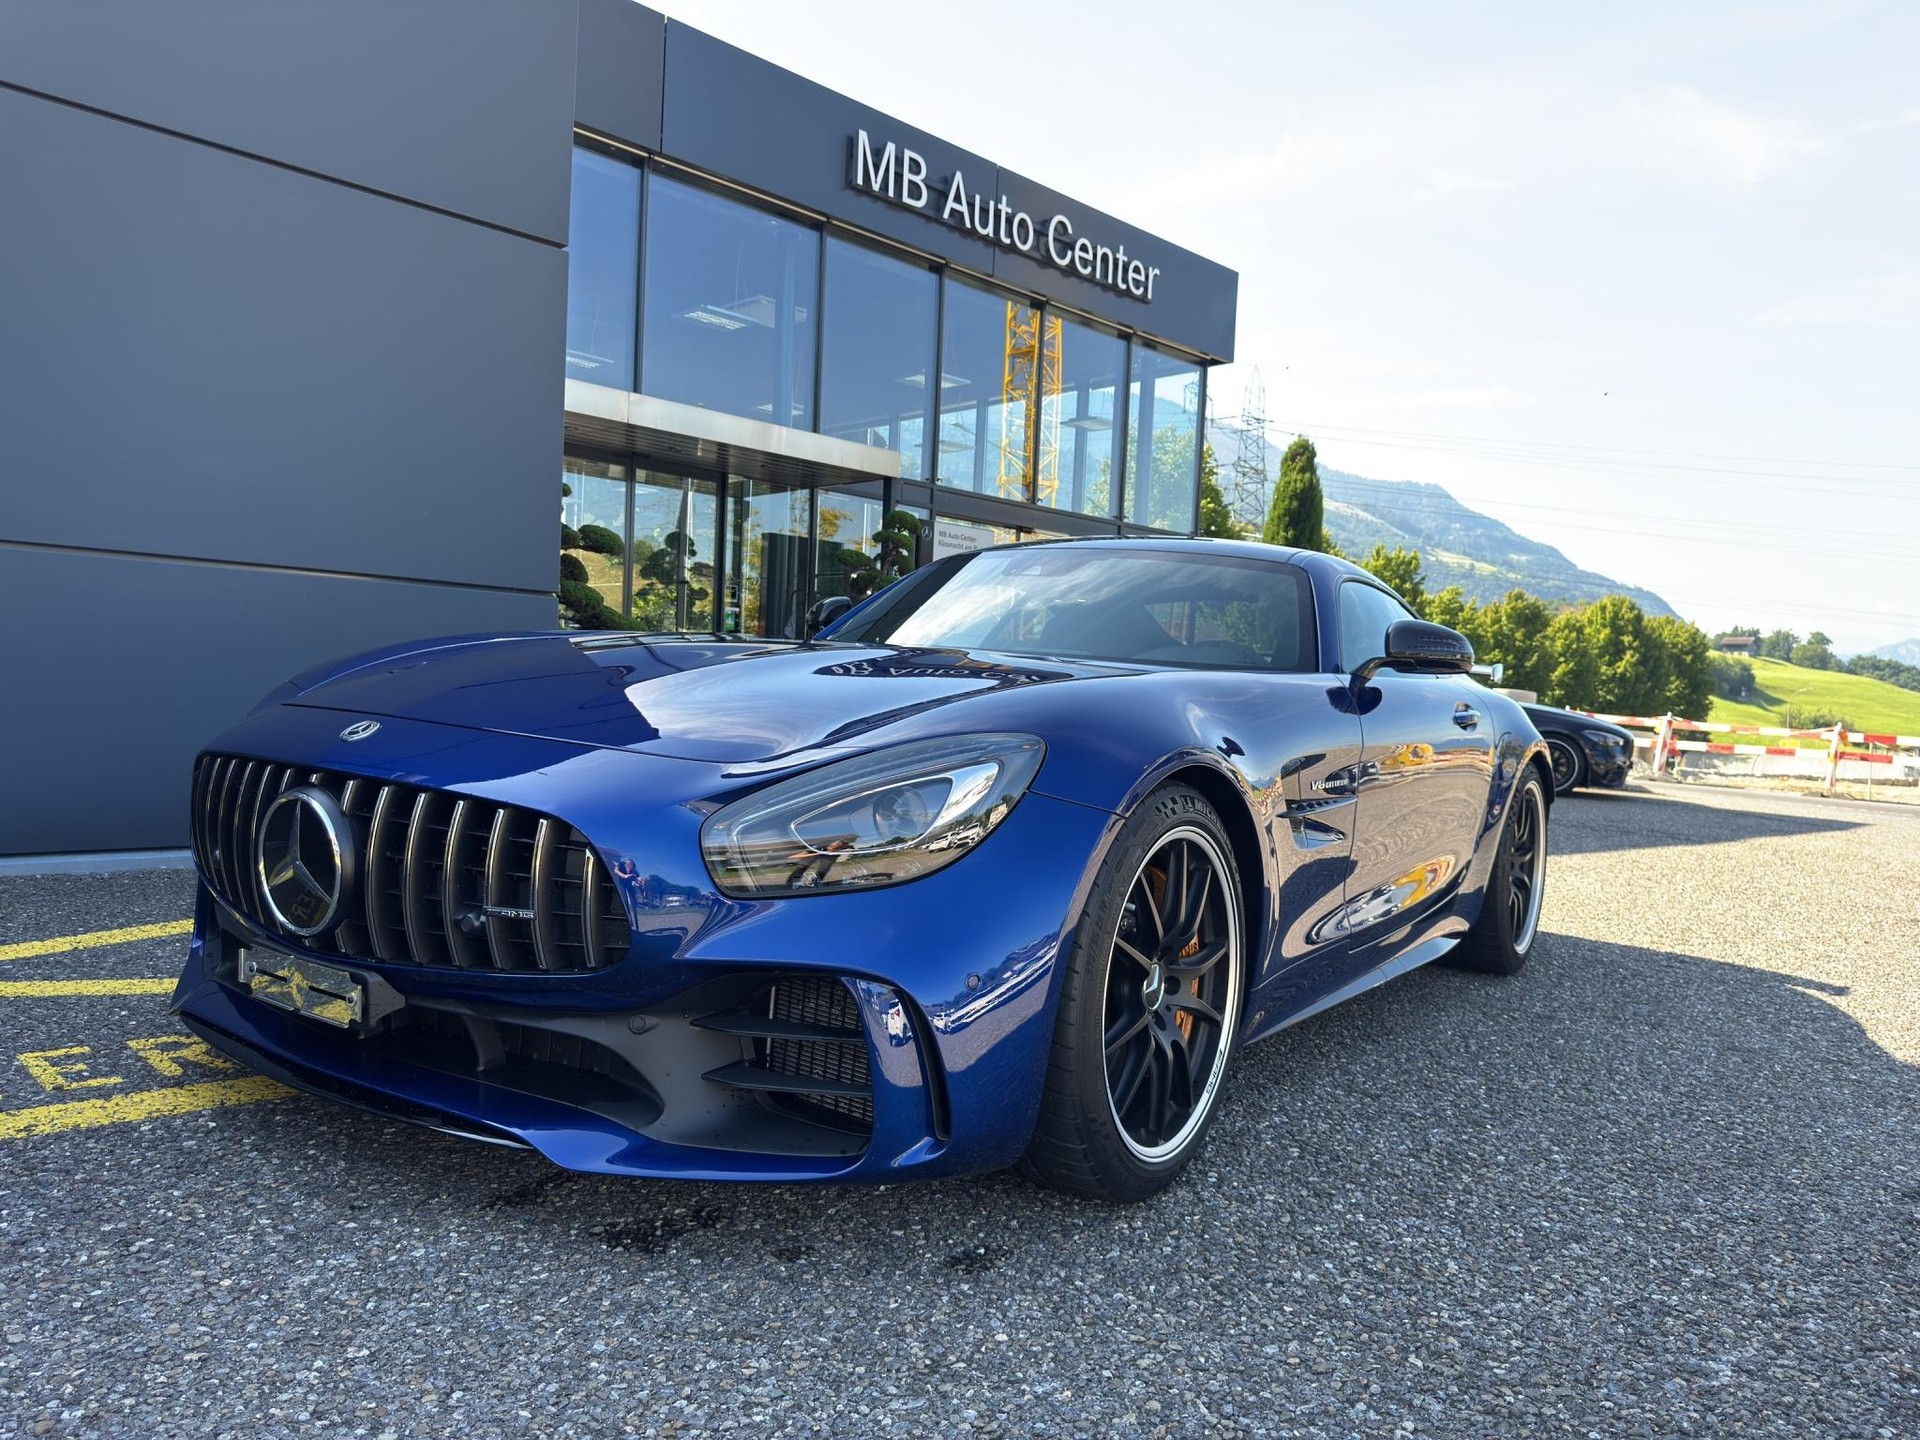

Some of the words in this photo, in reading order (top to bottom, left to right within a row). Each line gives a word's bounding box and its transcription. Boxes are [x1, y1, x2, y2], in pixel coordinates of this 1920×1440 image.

[856, 128, 927, 208] MB
[942, 171, 1034, 251] Auto
[1048, 214, 1160, 300] Center
